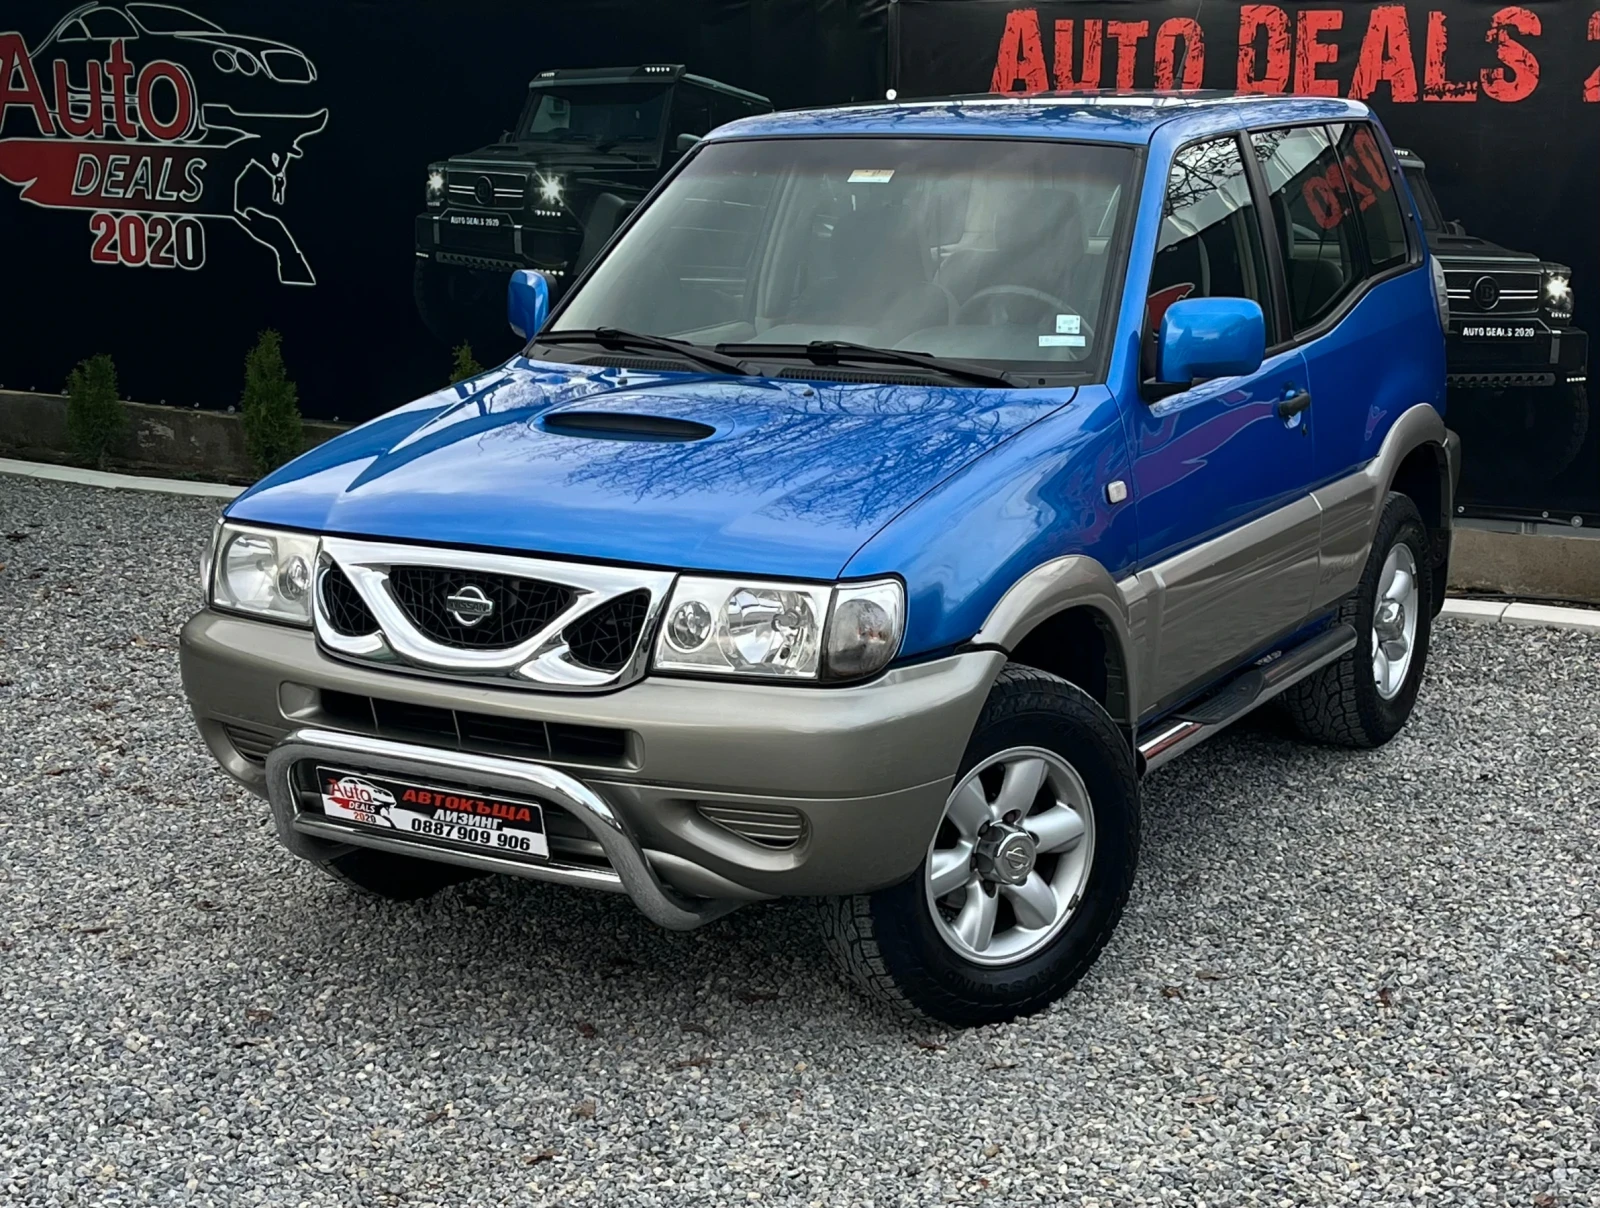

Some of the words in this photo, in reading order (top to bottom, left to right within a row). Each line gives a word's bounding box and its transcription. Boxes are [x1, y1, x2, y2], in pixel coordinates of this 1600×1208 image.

[989, 7, 1205, 93] AUTO
[1236, 4, 1542, 102] DEALS
[0, 32, 193, 141] Auto
[71, 153, 207, 202] DEALS
[451, 216, 465, 225] AUTO
[90, 211, 205, 270] 2020
[1462, 327, 1484, 336] AUTO
[1486, 327, 1512, 337] DEALS
[1514, 327, 1535, 337] 2020
[449, 601, 489, 613] NISSAN
[330, 779, 374, 803] Auto
[348, 801, 375, 813] DEALS
[353, 811, 377, 824] 2020
[402, 789, 531, 822] АВТОКЪЩА
[433, 808, 503, 830] ЛИЗИНГ
[411, 818, 456, 837] 0887
[457, 826, 491, 844] 909
[497, 833, 531, 851] 906
